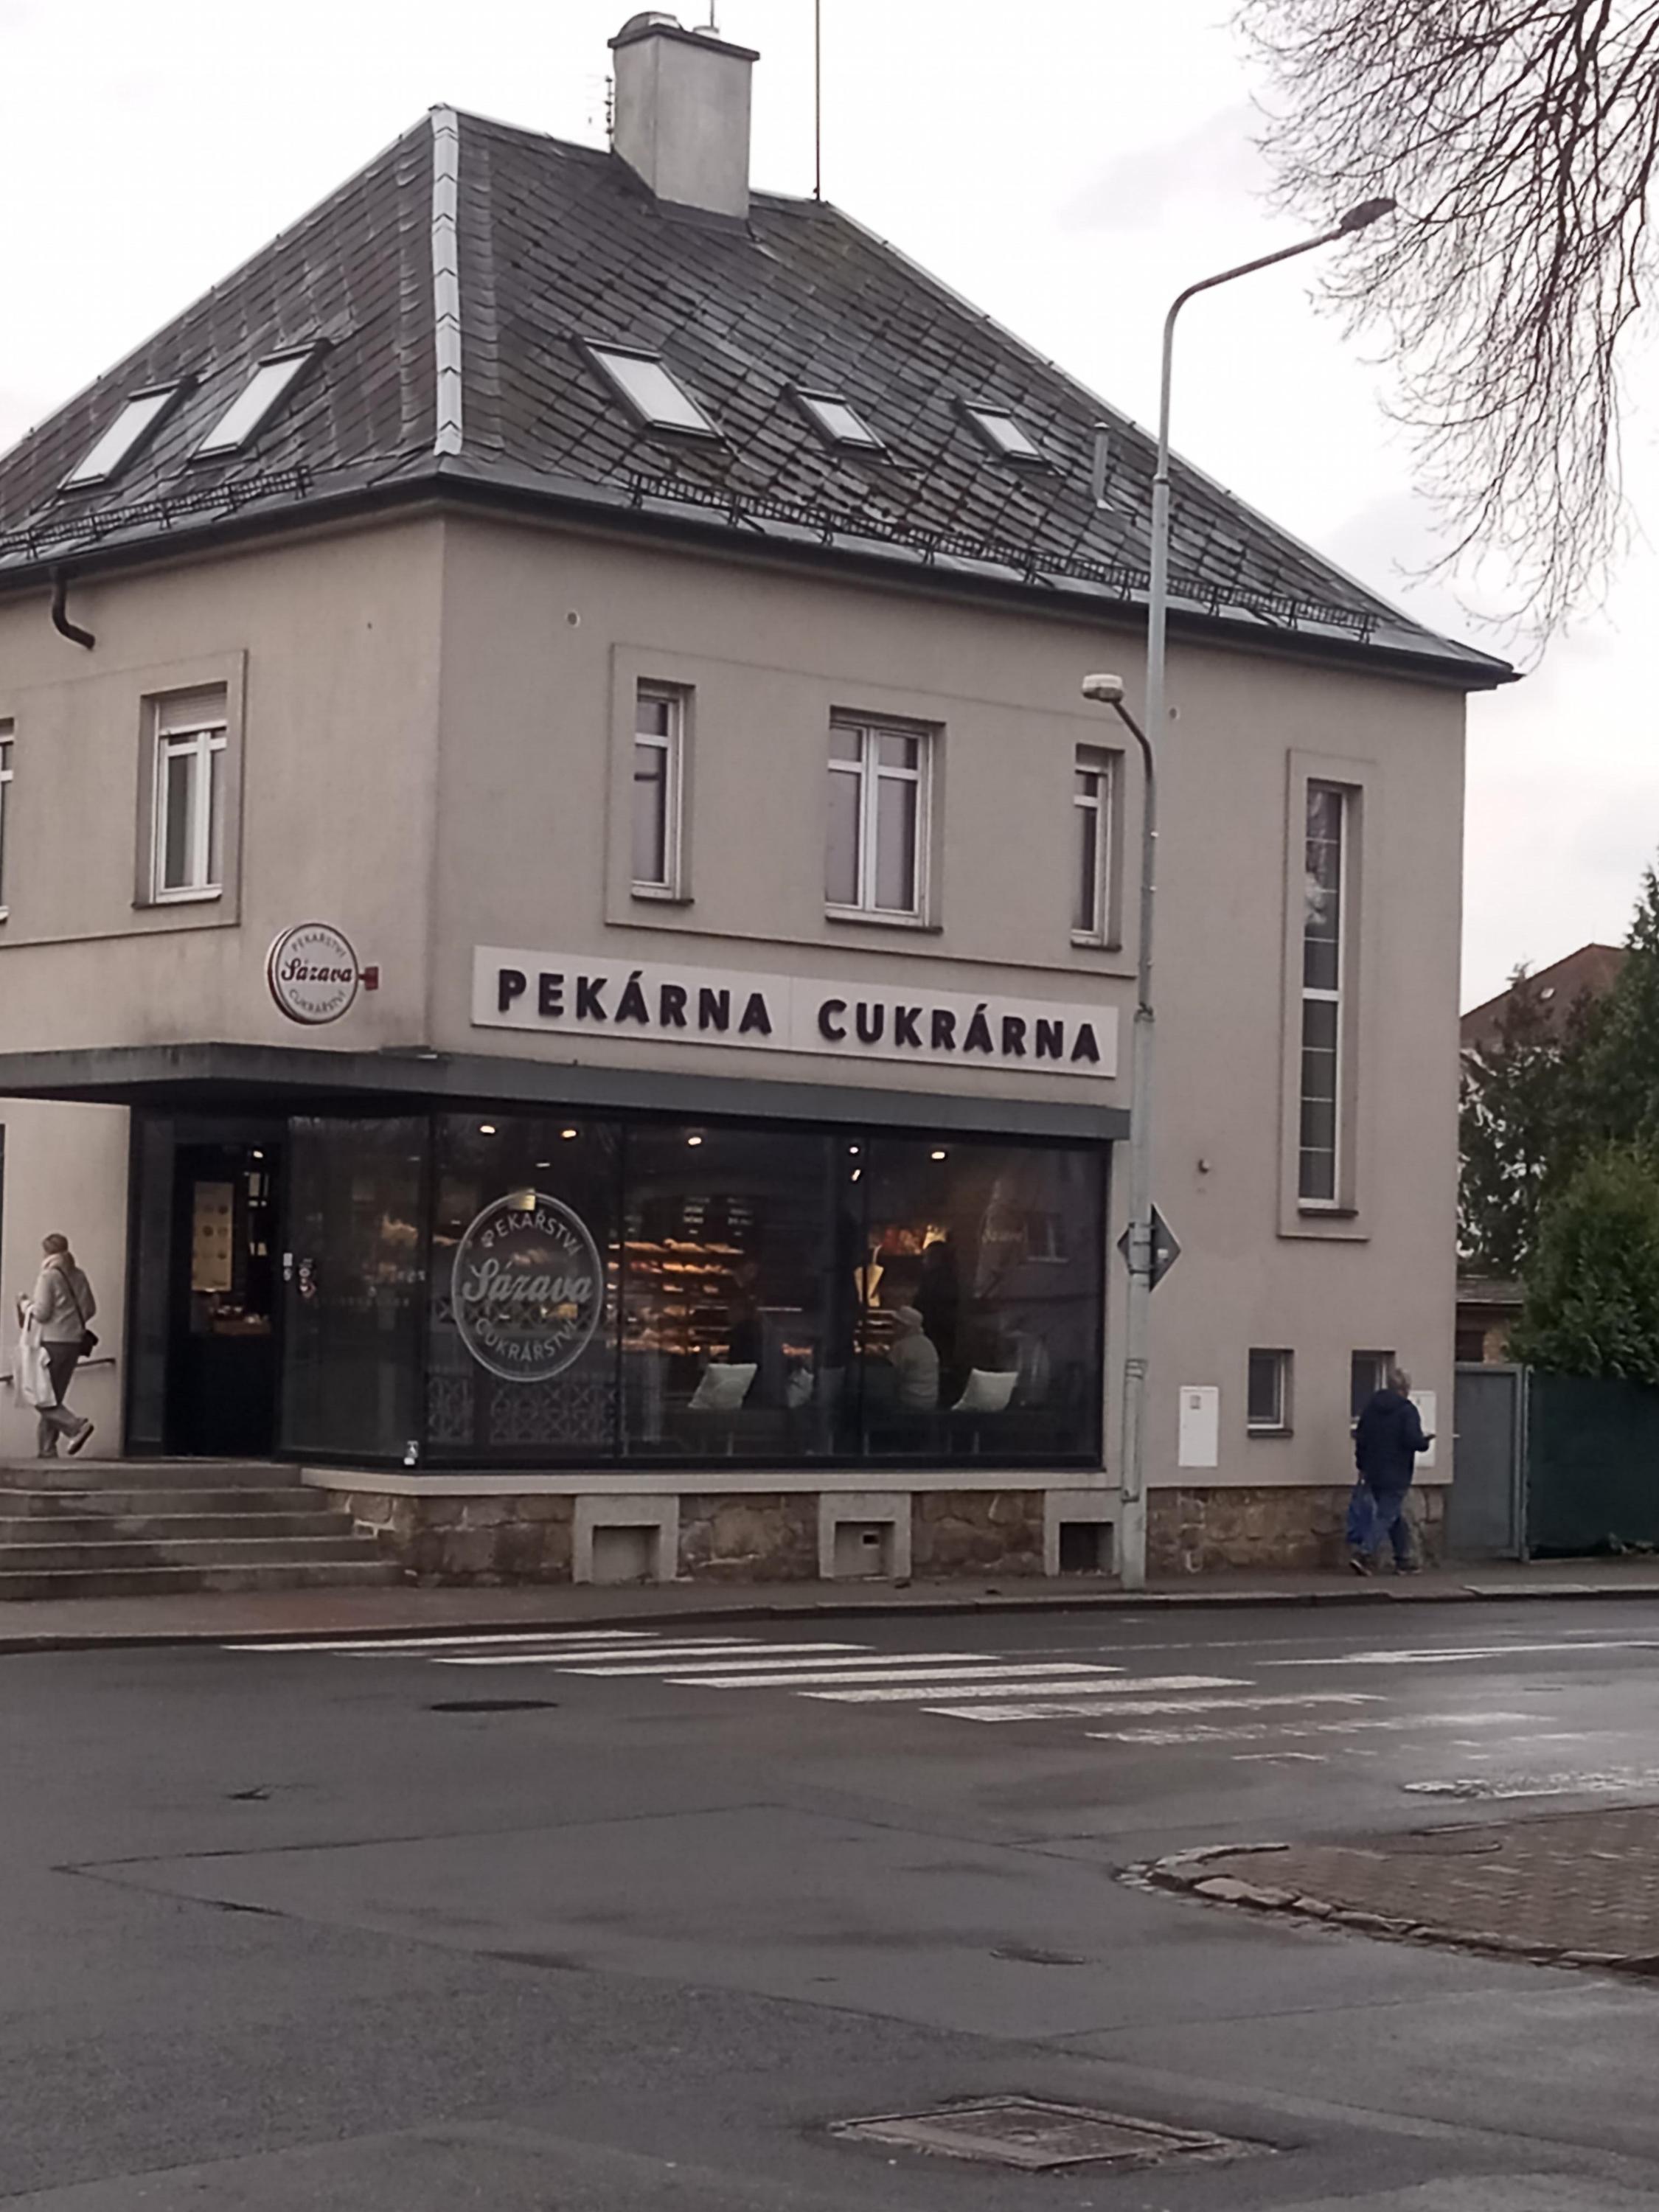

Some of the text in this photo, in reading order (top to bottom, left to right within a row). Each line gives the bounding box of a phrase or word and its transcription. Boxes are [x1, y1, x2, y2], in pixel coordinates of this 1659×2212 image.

[281, 958, 353, 983] Sázava
[498, 968, 1100, 1064] PEKÁRNA CUKRÁRNA
[481, 1208, 584, 1256] PEKAŘSTVÍ
[462, 1257, 593, 1304] Sázava
